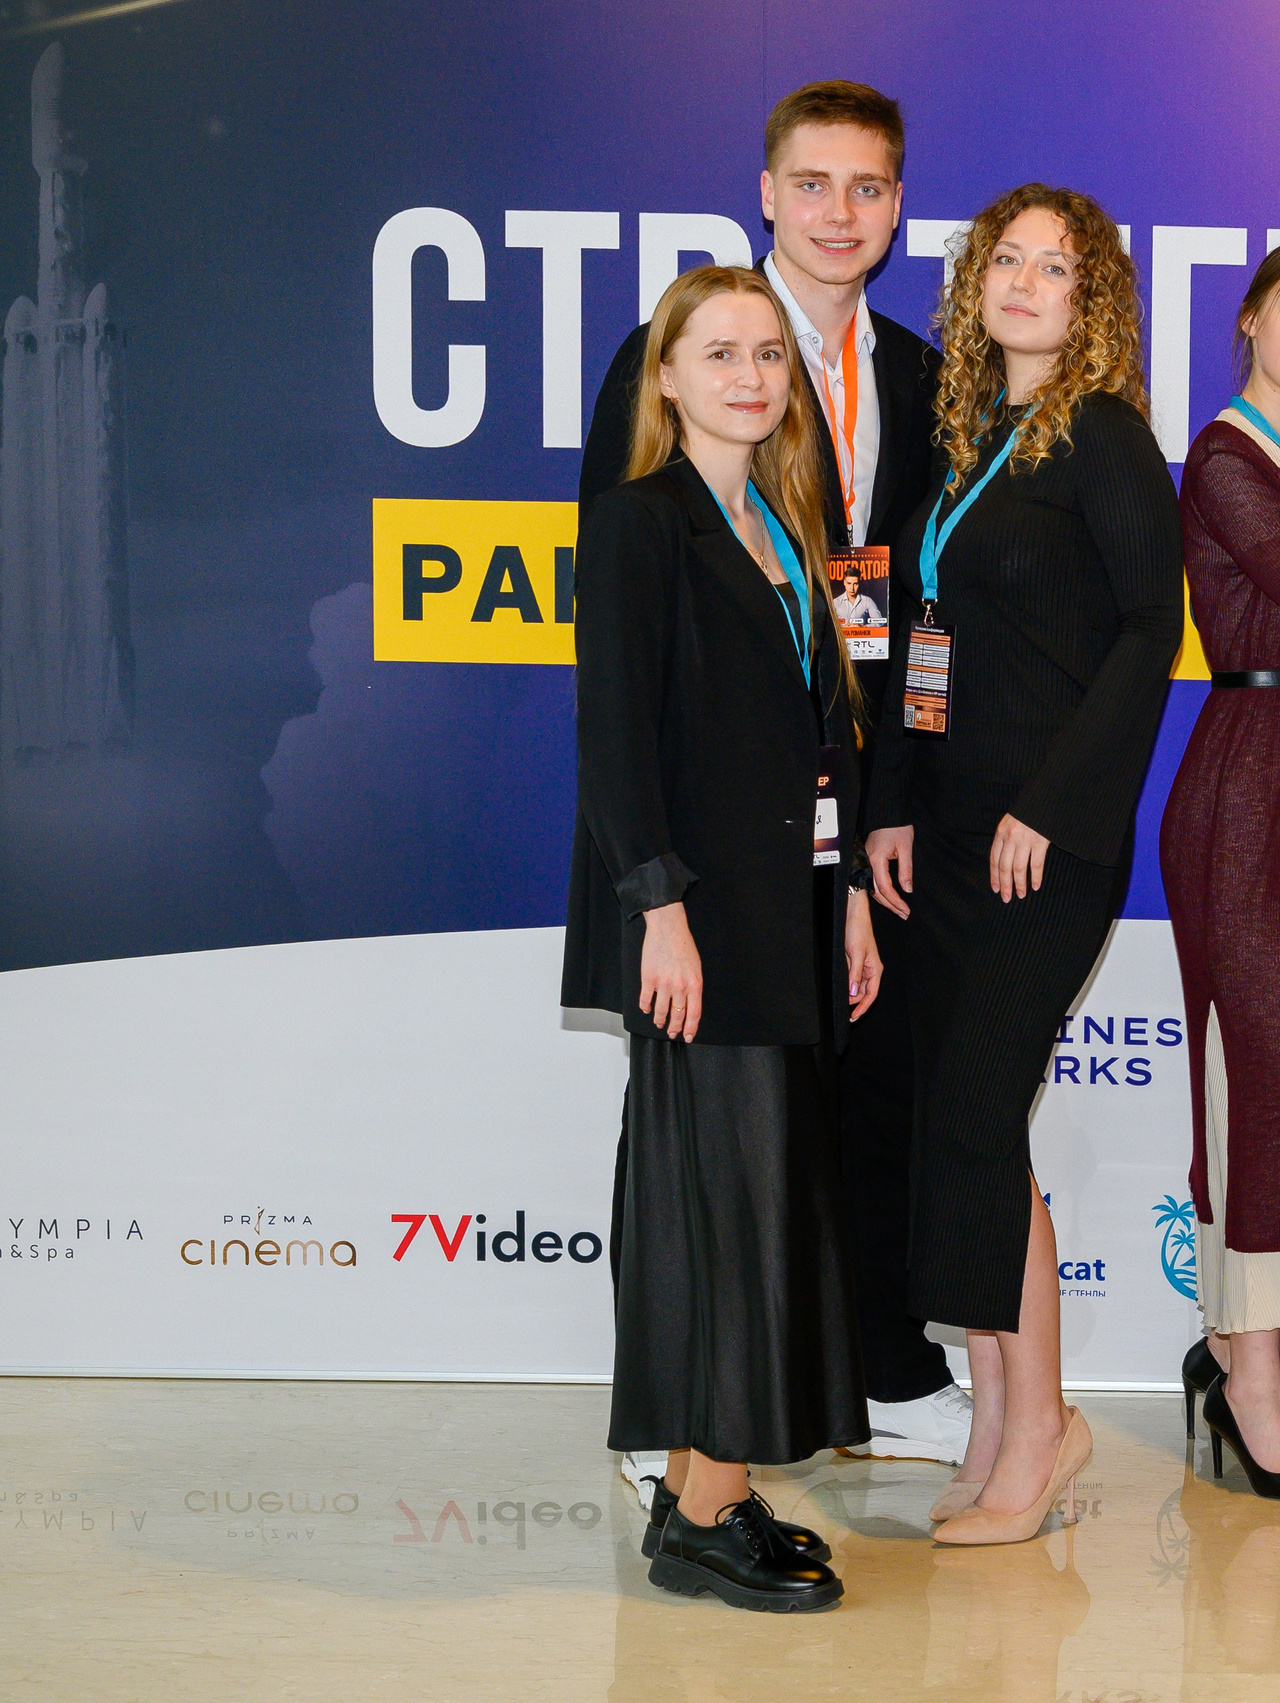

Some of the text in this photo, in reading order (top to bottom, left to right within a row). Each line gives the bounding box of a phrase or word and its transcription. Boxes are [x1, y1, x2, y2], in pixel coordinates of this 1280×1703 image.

[1042, 1056, 1153, 1086] RKS
[391, 1209, 603, 1264] 7Video
[180, 1239, 357, 1267] cinema
